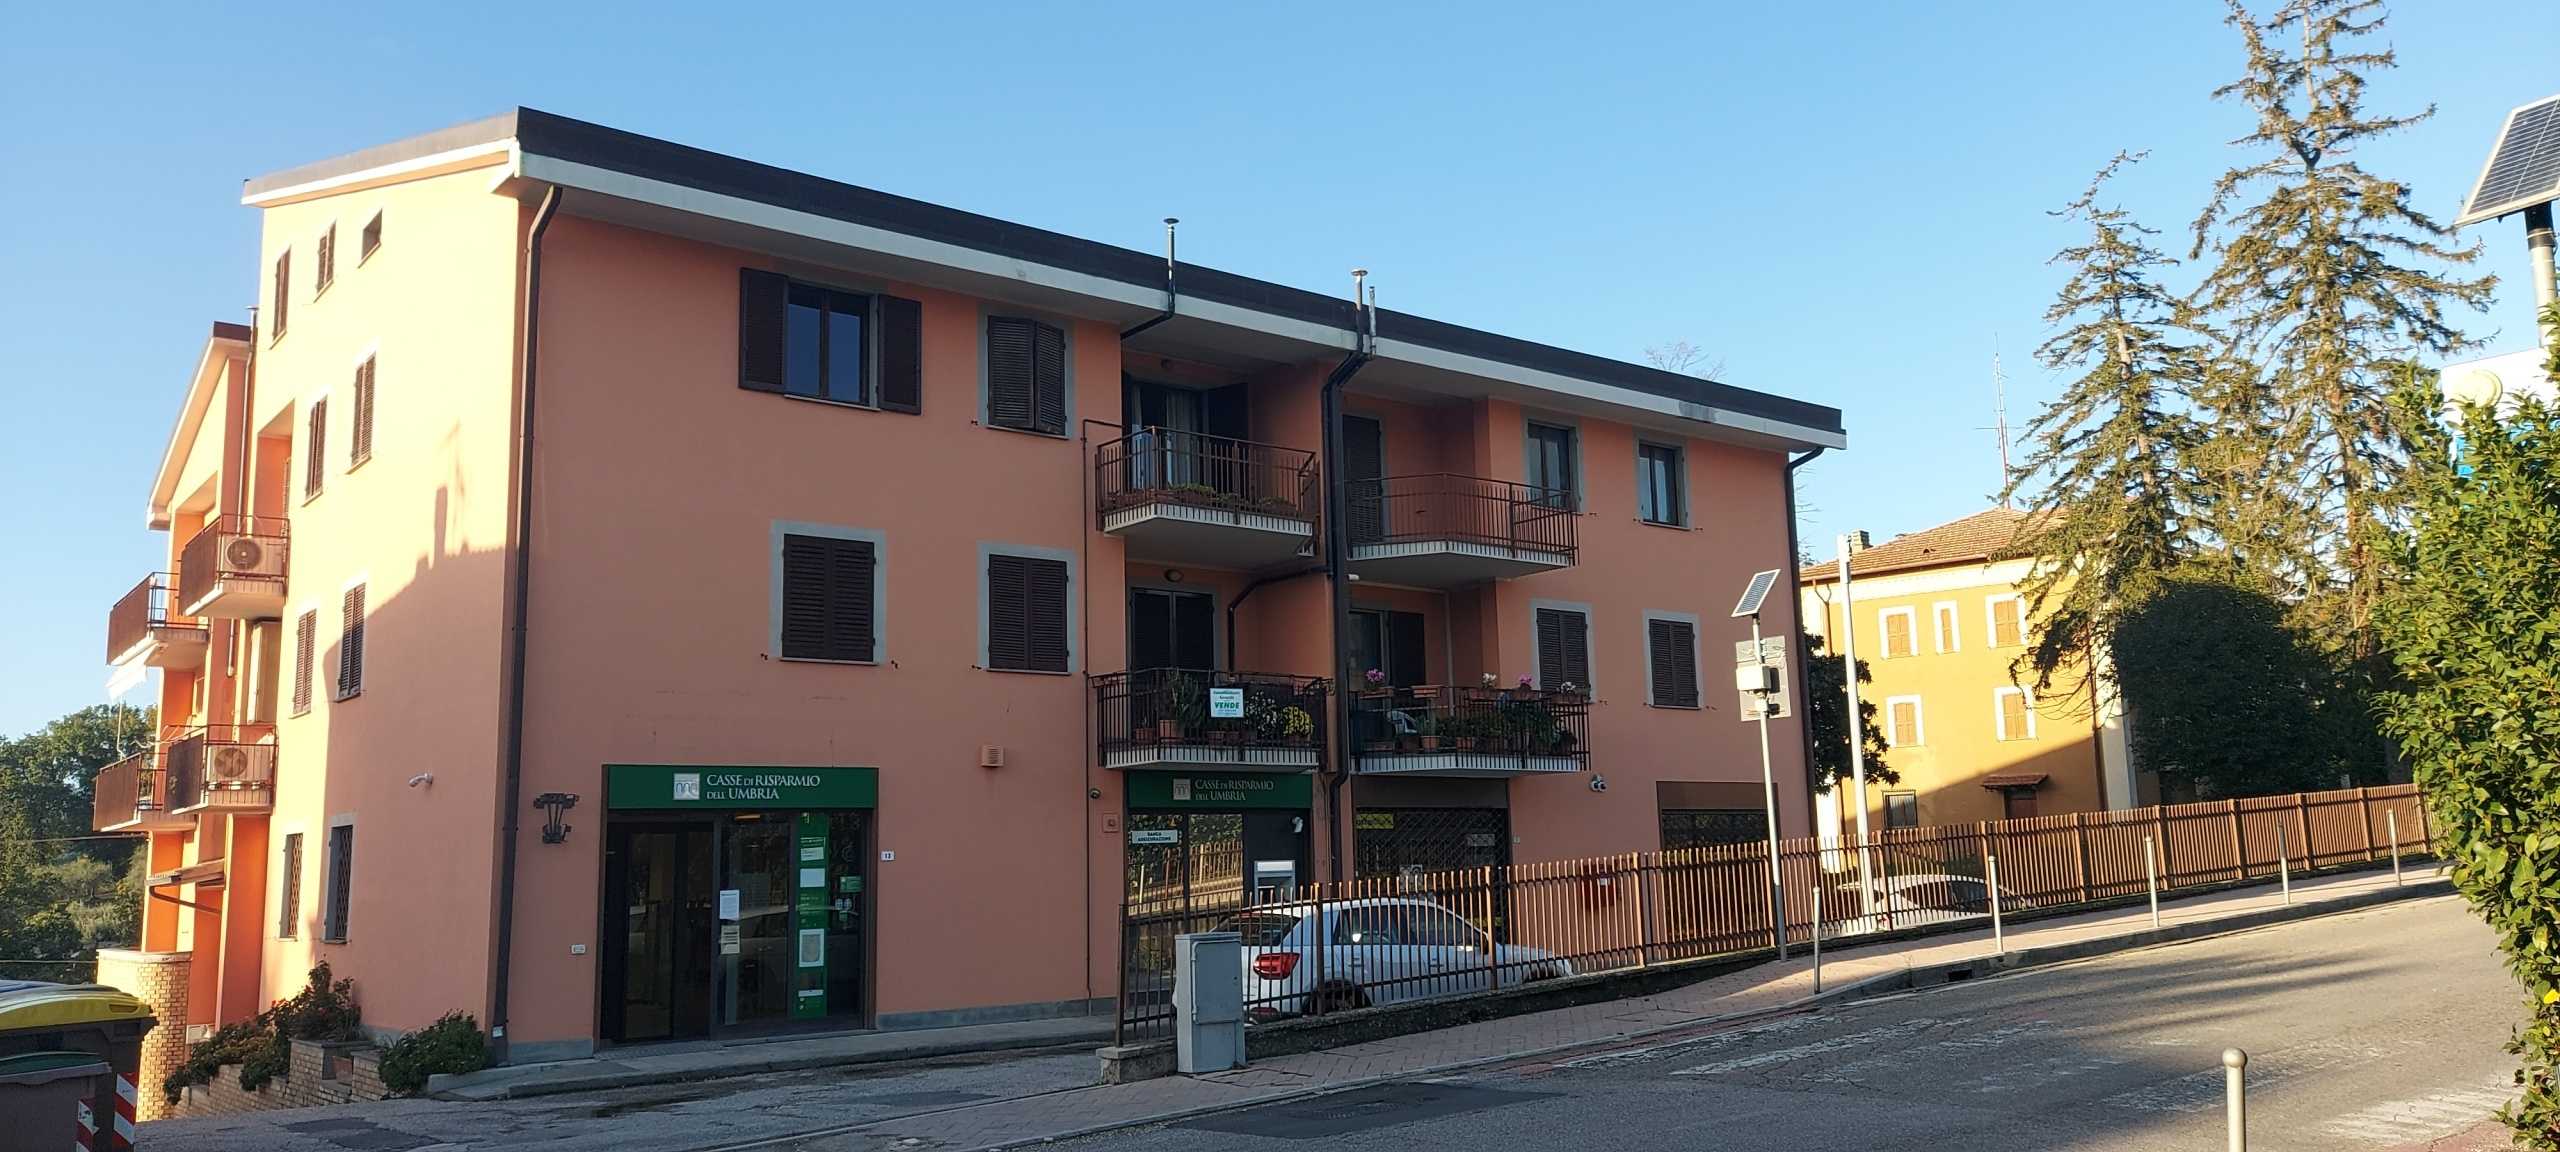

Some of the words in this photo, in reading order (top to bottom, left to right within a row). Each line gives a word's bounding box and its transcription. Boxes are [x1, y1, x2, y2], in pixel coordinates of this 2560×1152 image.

[706, 774, 744, 786] CASSE
[744, 778, 754, 786] DI
[755, 775, 821, 787] RISPARMIO
[1194, 779, 1219, 790] CASSE
[1228, 779, 1274, 790] RISPARMIO
[728, 787, 780, 800] UMBRIA
[1210, 790, 1246, 801] UMBRIA
